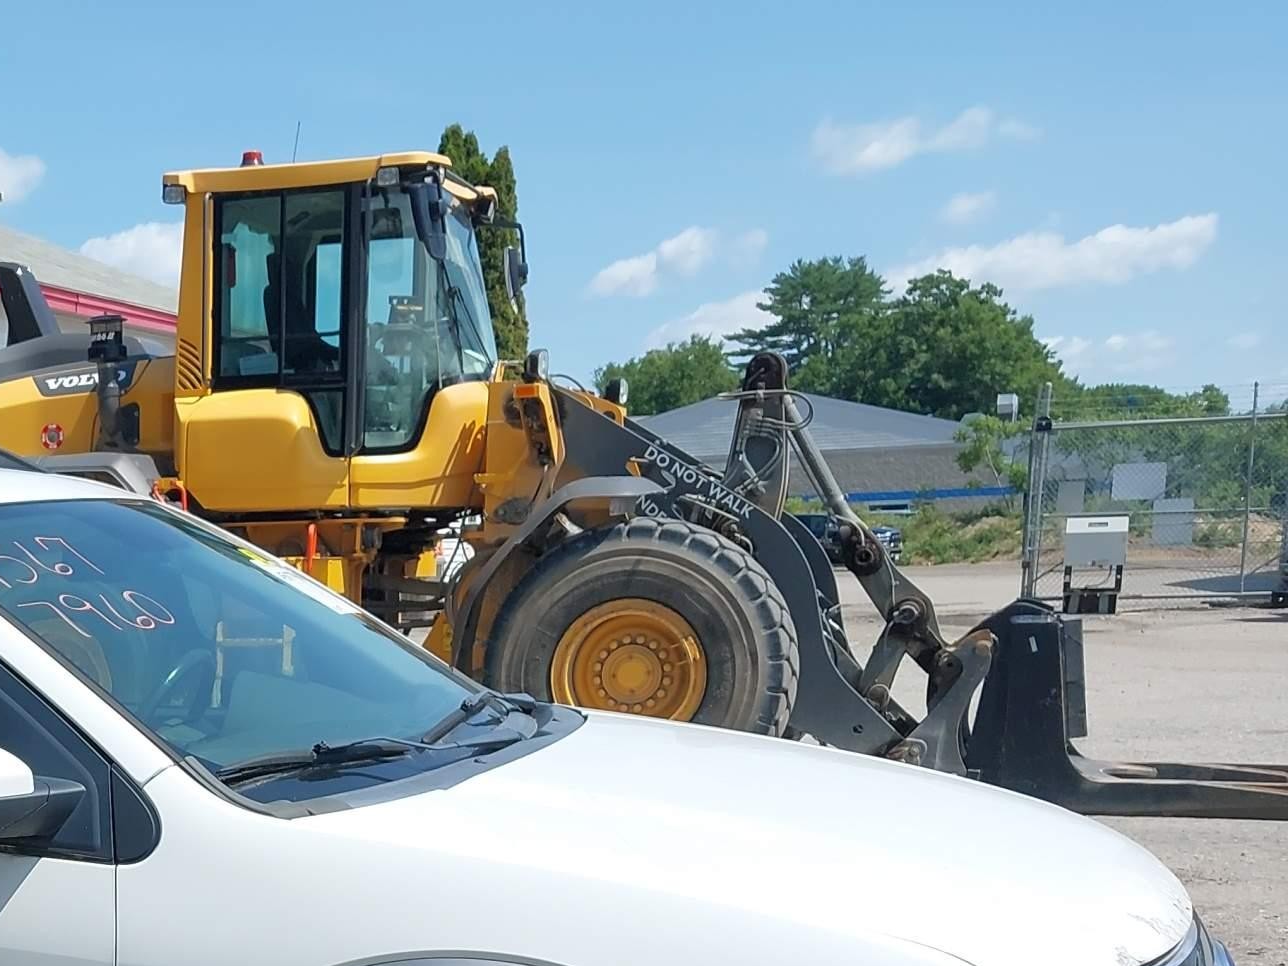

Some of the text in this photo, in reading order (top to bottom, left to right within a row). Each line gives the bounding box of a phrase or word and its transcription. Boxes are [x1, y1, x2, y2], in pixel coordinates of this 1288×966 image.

[644, 446, 754, 519] DO NOT WALK
[17, 590, 175, 638] 7960
